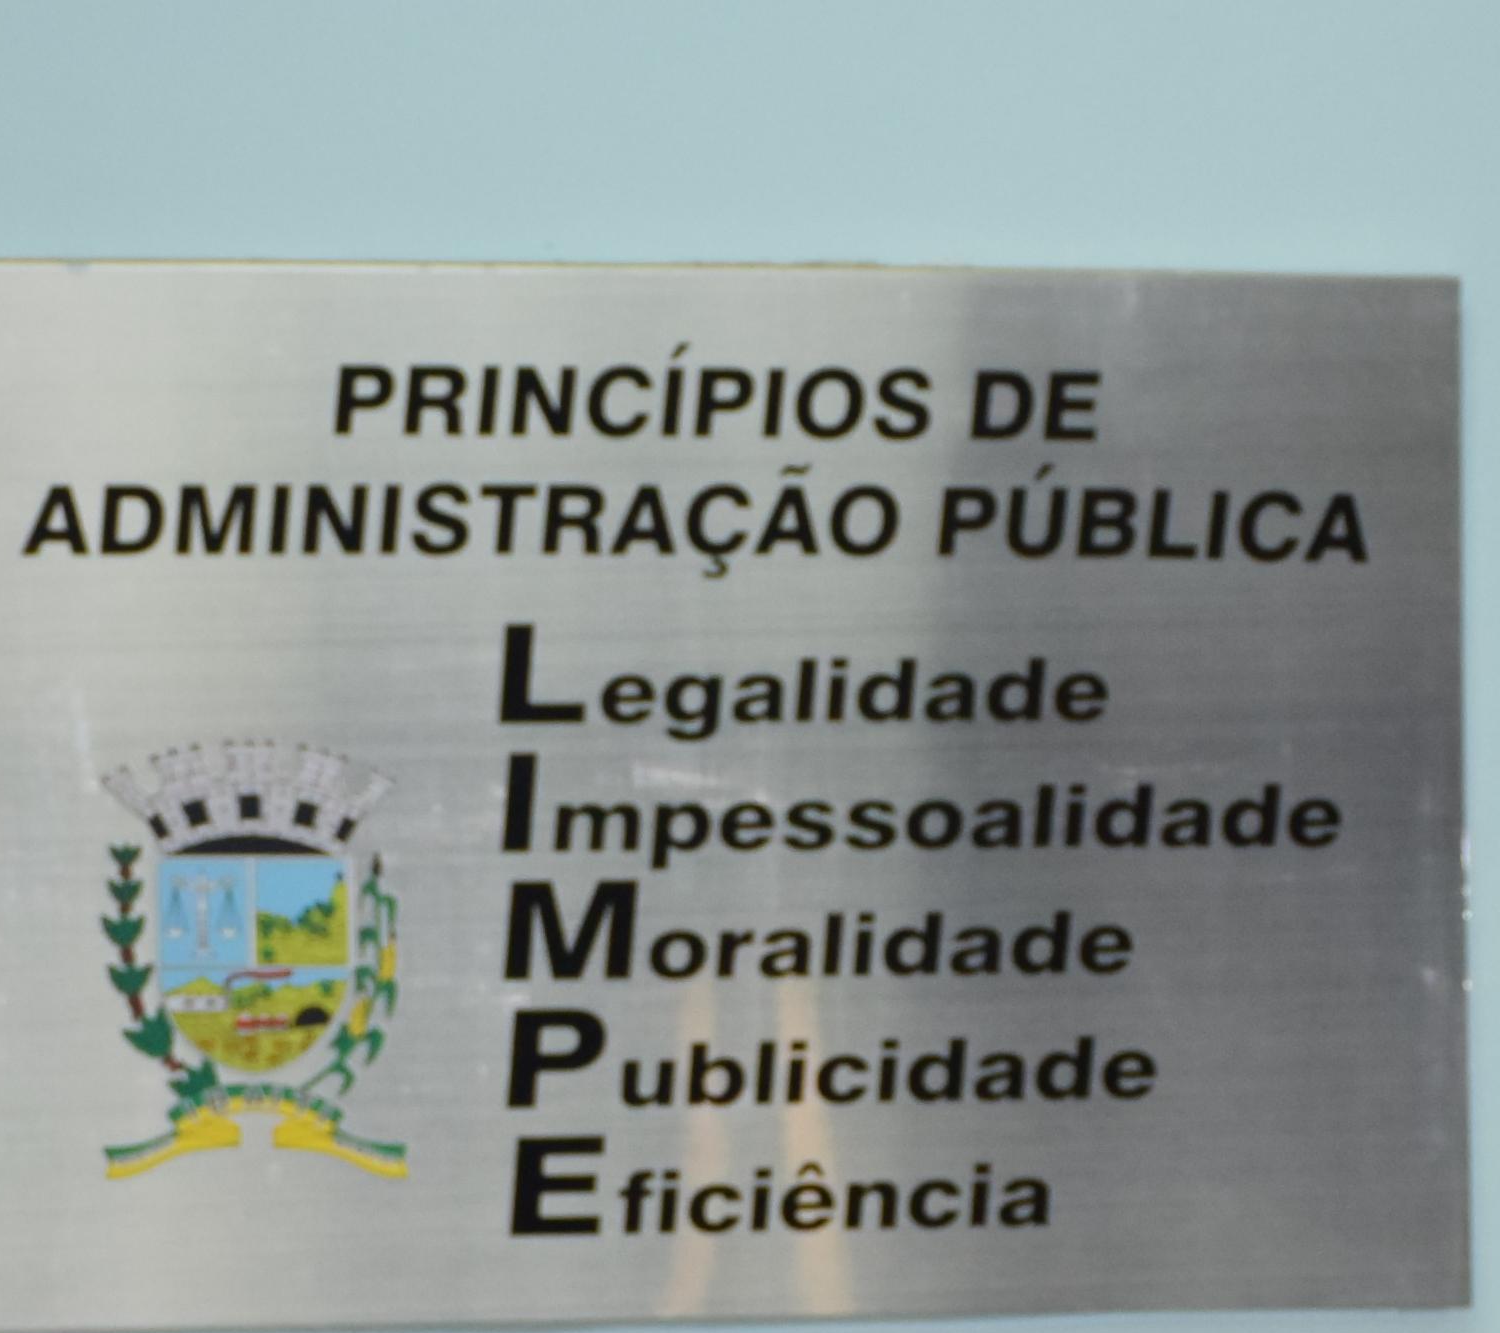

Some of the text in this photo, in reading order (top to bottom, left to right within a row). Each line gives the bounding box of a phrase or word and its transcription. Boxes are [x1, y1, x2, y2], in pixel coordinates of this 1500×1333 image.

[334, 344, 1102, 442] PRINCÍPIOS DE
[23, 463, 1370, 577] ADMINISTRAÇÃO PÚBLICA
[499, 623, 1111, 742] Legalidade
[501, 752, 1345, 871] Impessoalidade
[504, 879, 1135, 981] Moralidade
[506, 1008, 1159, 1109] Publicidade
[509, 1135, 1051, 1236] Eficiência
